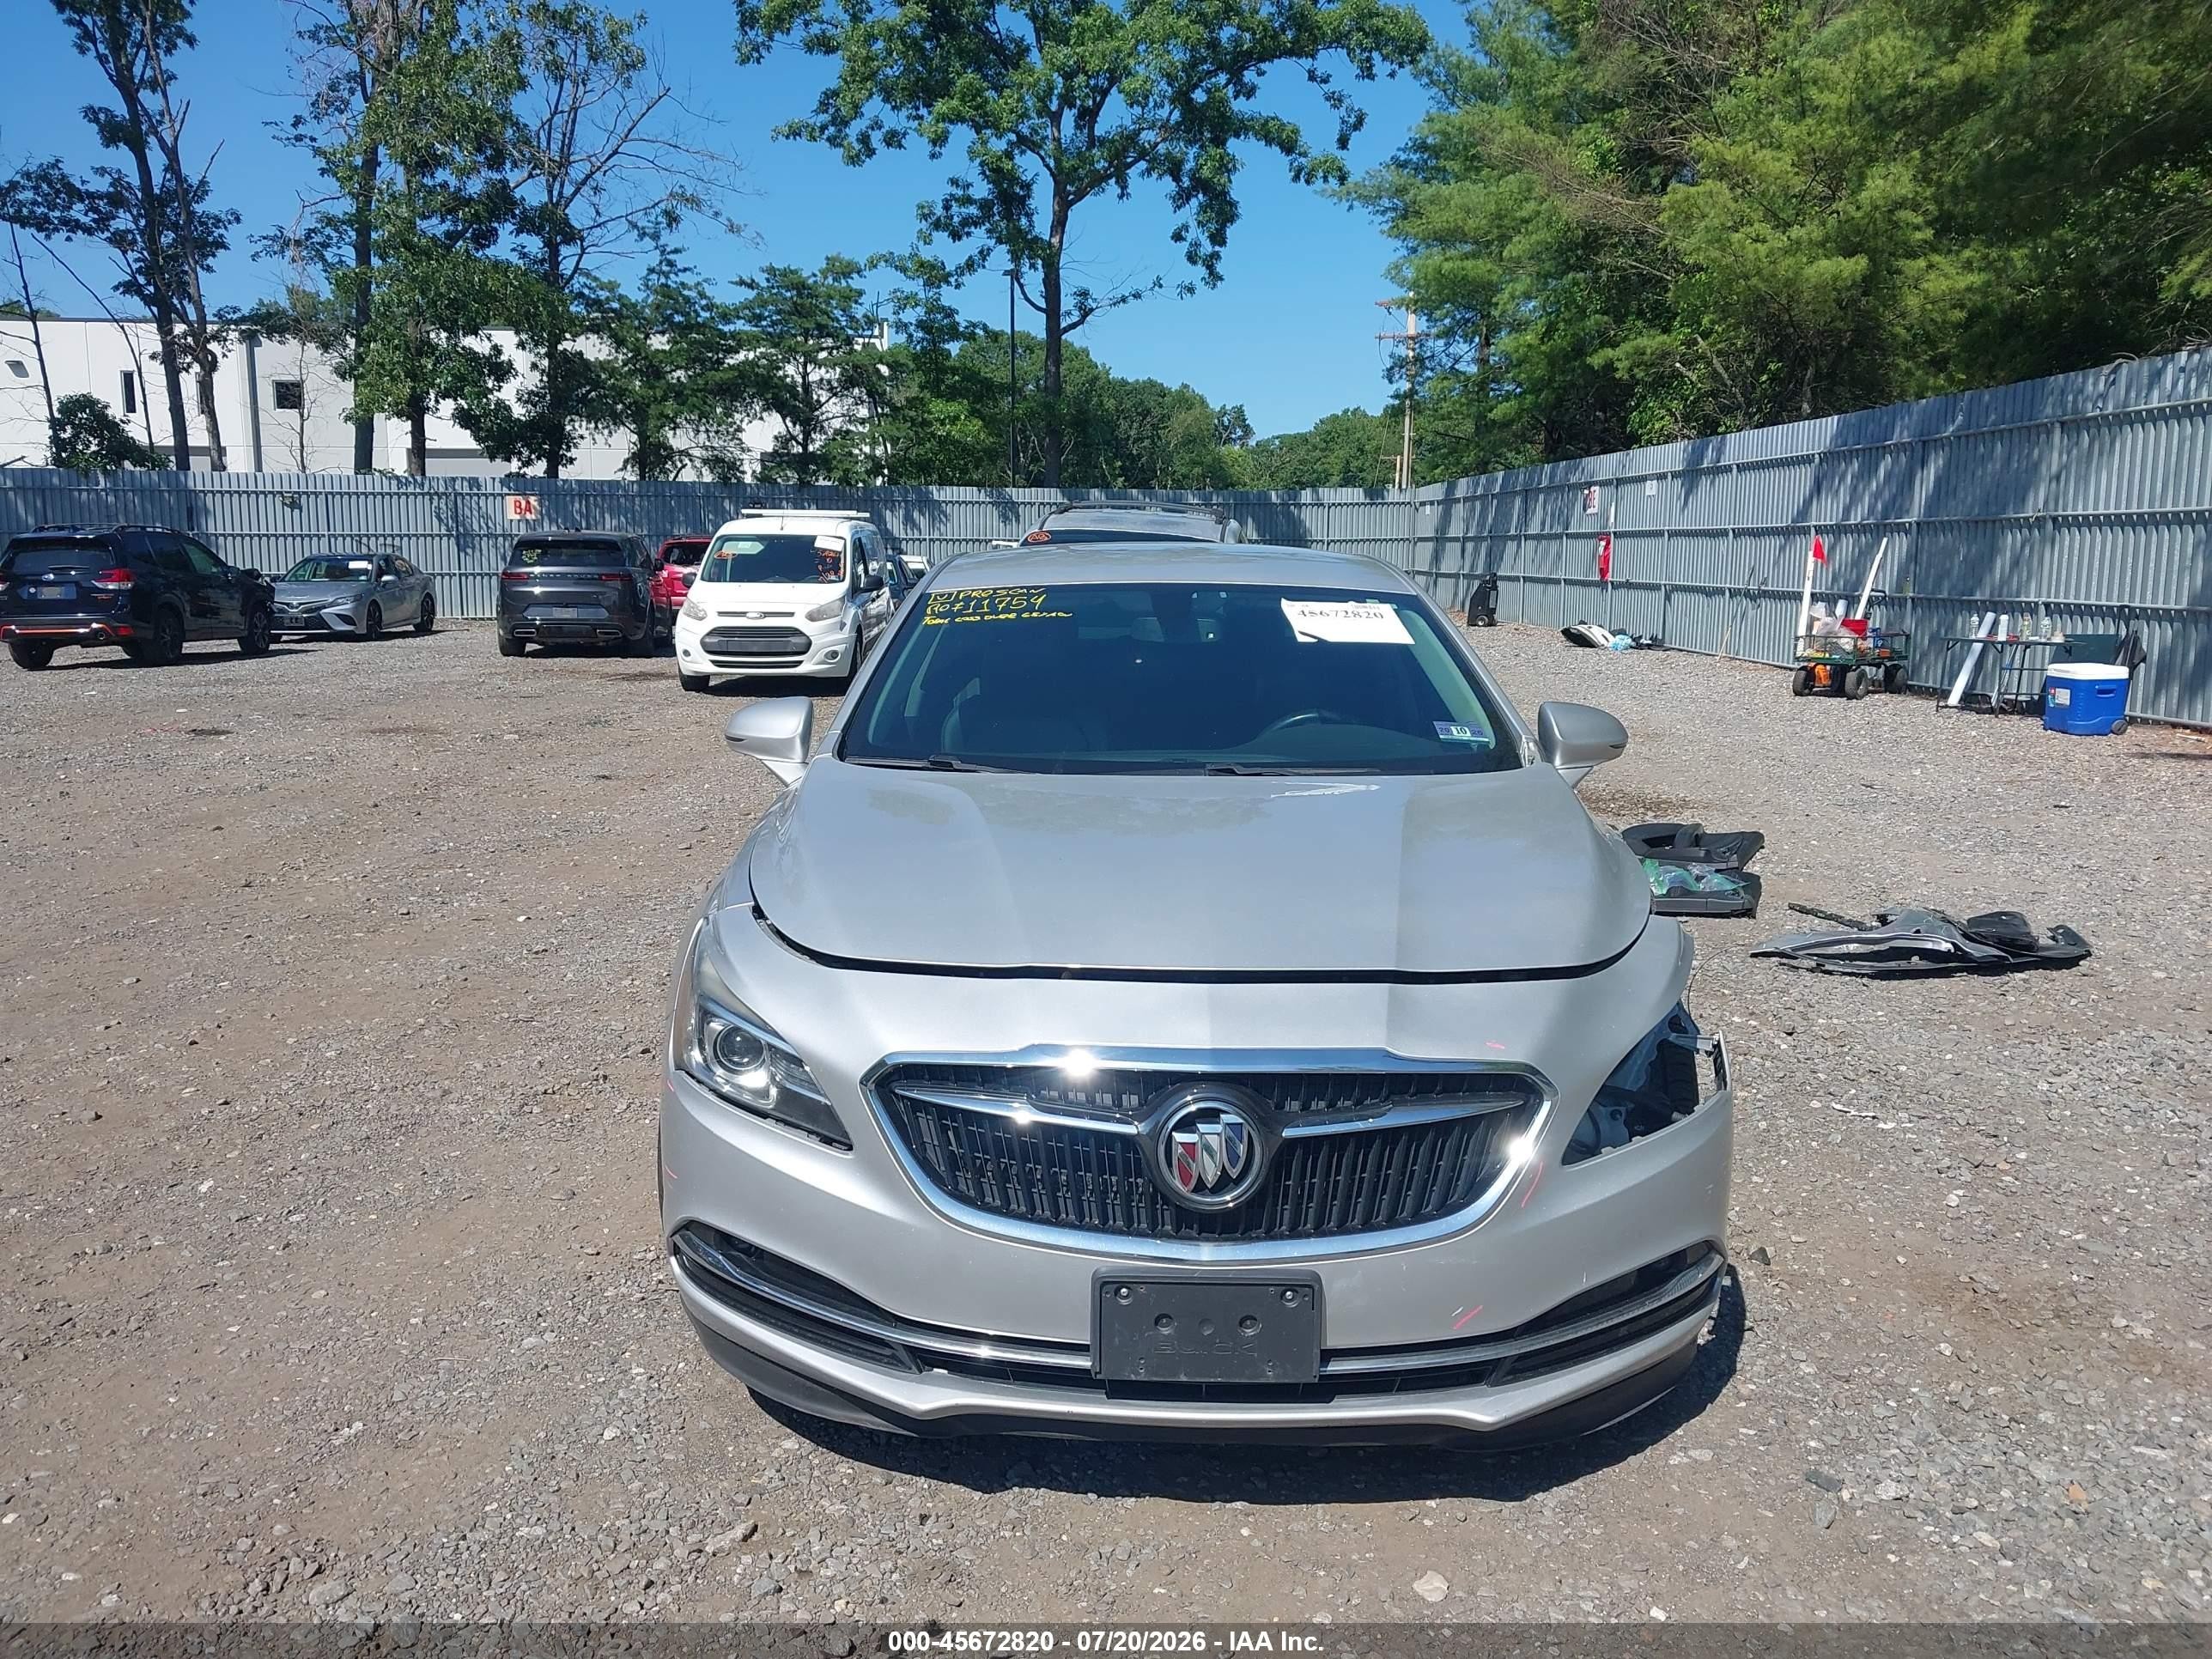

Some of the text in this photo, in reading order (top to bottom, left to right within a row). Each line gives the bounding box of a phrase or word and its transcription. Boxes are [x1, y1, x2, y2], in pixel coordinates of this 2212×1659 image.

[513, 500, 533, 515] BA
[1297, 609, 1384, 619] 45672820
[1455, 726, 1468, 735] 10
